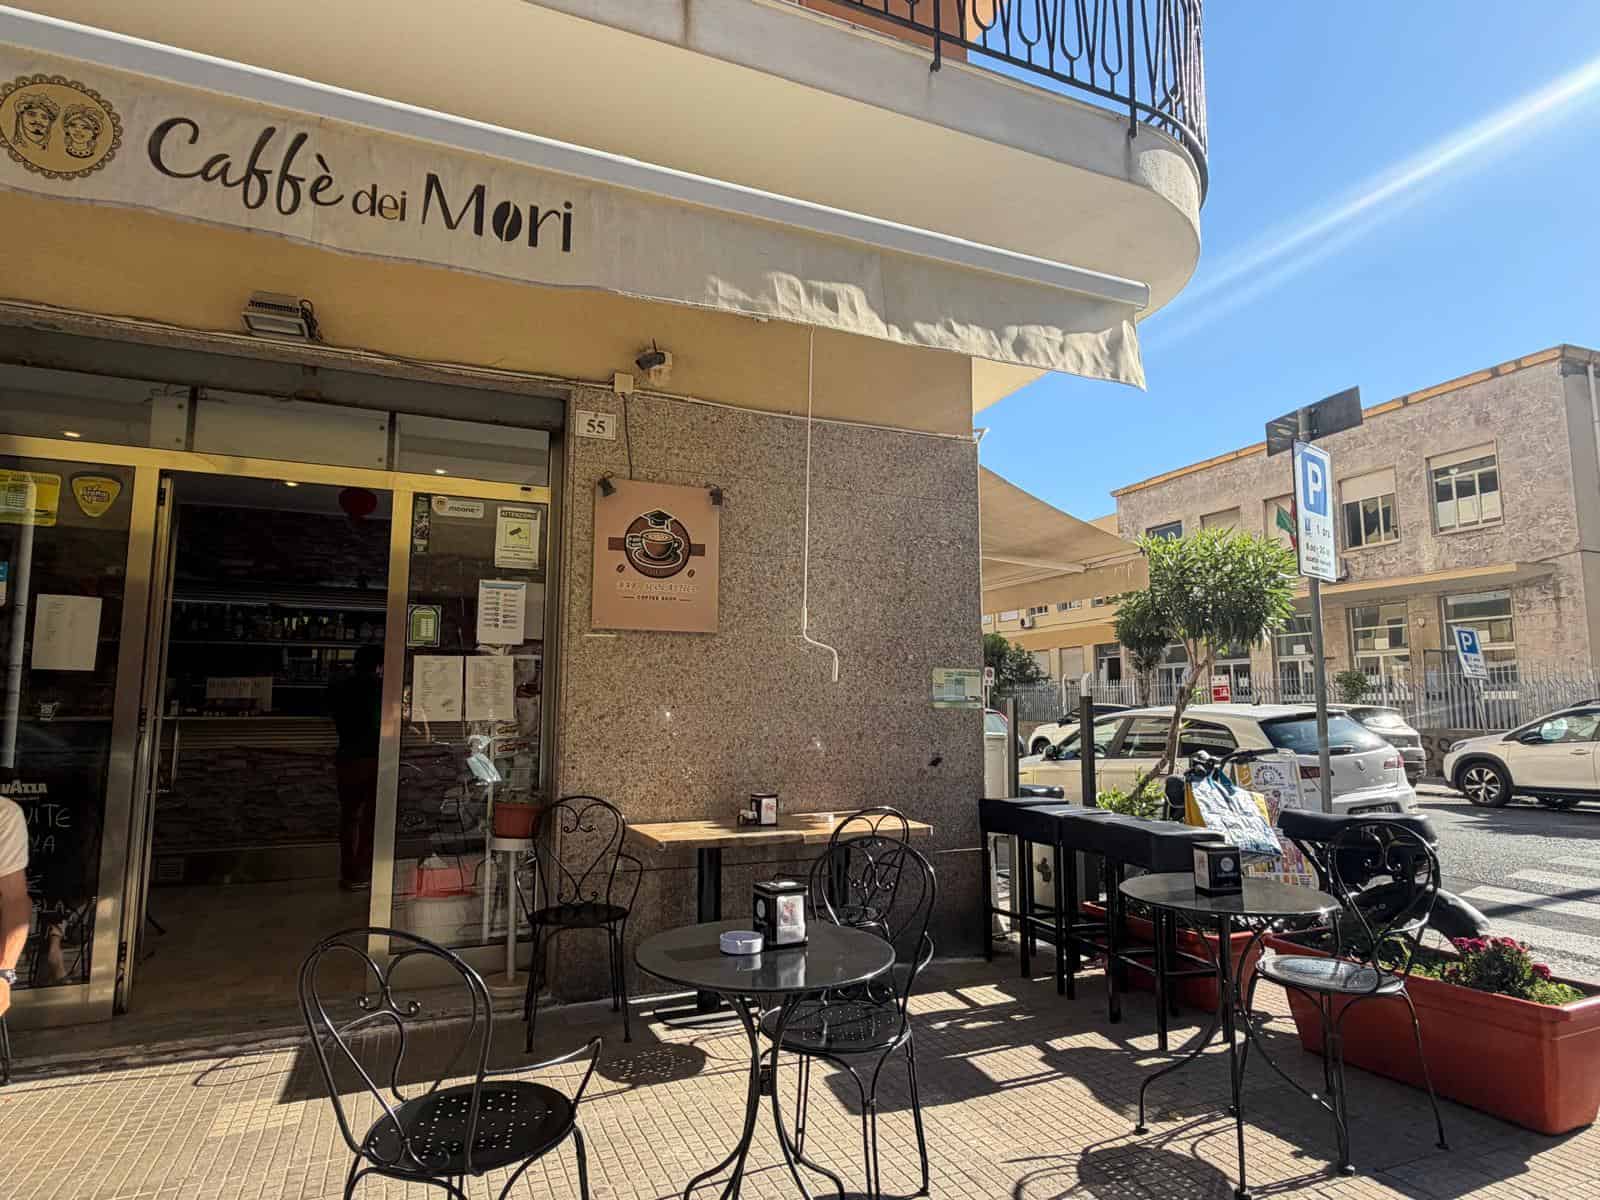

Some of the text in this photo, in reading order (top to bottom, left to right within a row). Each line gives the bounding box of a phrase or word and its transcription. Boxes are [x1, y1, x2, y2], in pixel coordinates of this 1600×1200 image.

[147, 117, 574, 253] Caffè dei Mori
[586, 418, 606, 435] 55
[1306, 460, 1322, 506] P
[1460, 631, 1473, 652] P
